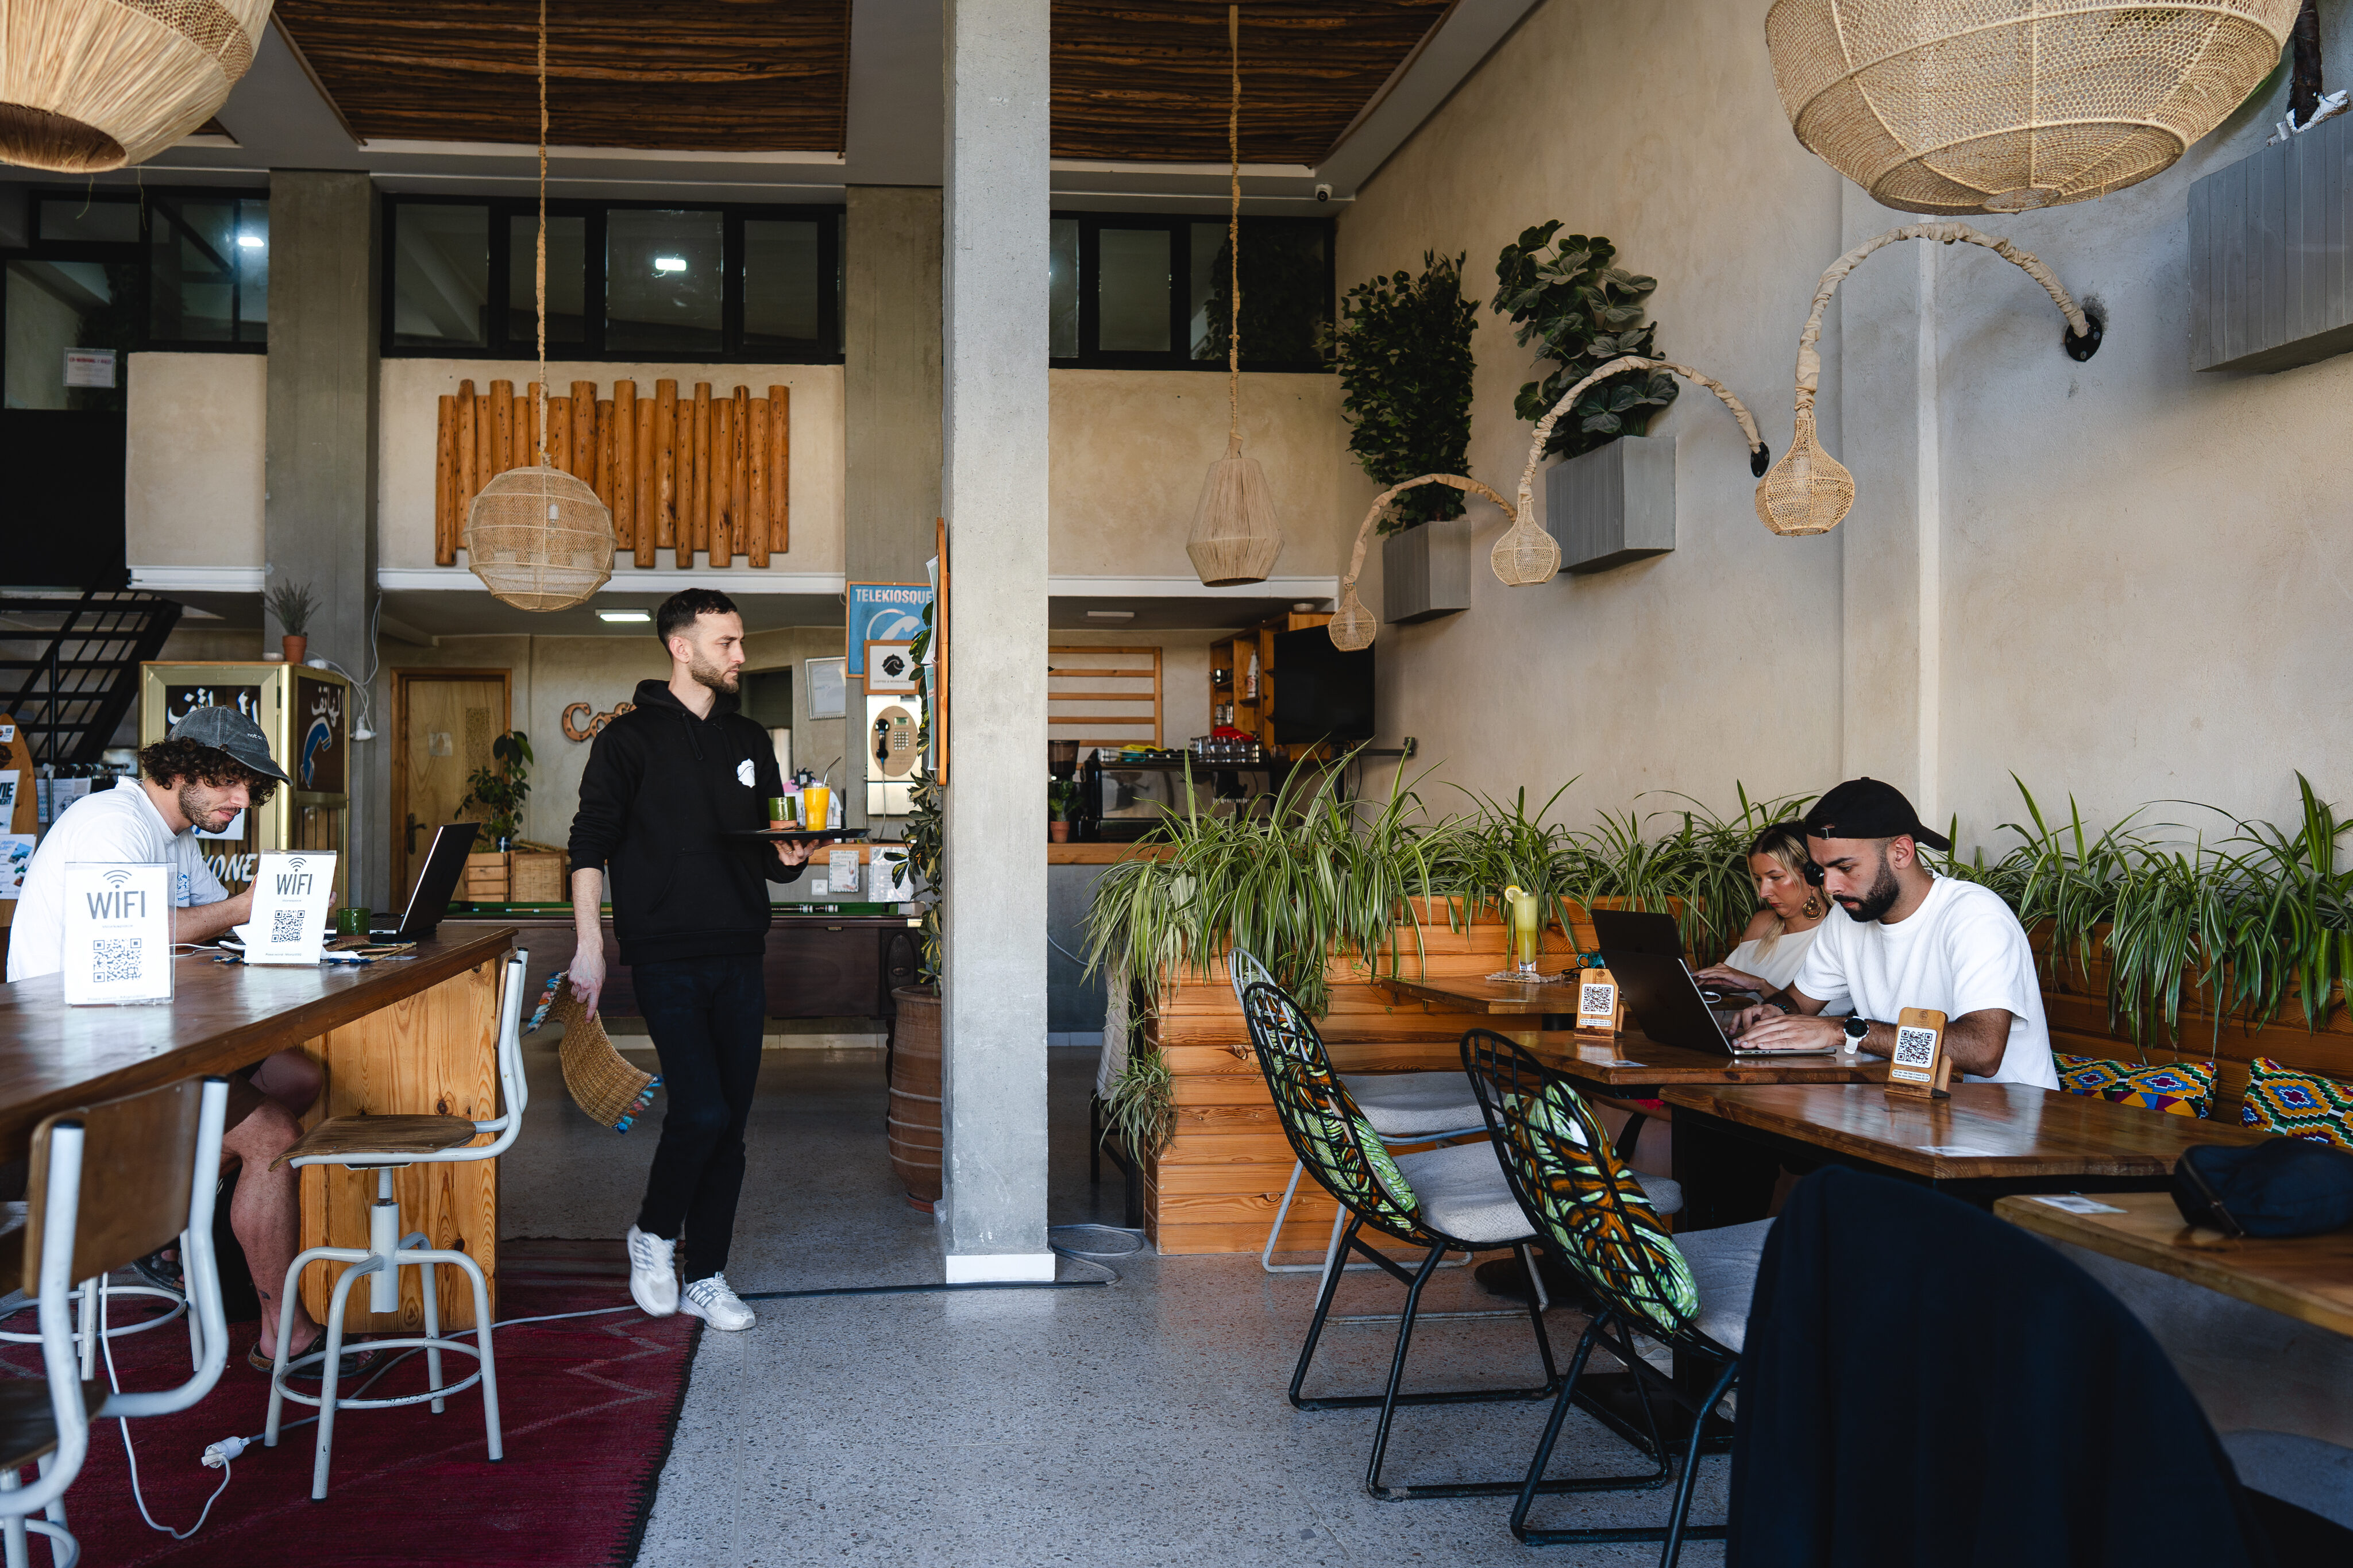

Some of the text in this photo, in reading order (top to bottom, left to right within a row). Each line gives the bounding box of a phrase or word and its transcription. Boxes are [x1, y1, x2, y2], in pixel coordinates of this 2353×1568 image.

[855, 589, 932, 605] TELEKIOSQUE
[311, 686, 345, 728] الهاتف
[277, 874, 313, 895] WIFI
[87, 891, 145, 919] WIFI
